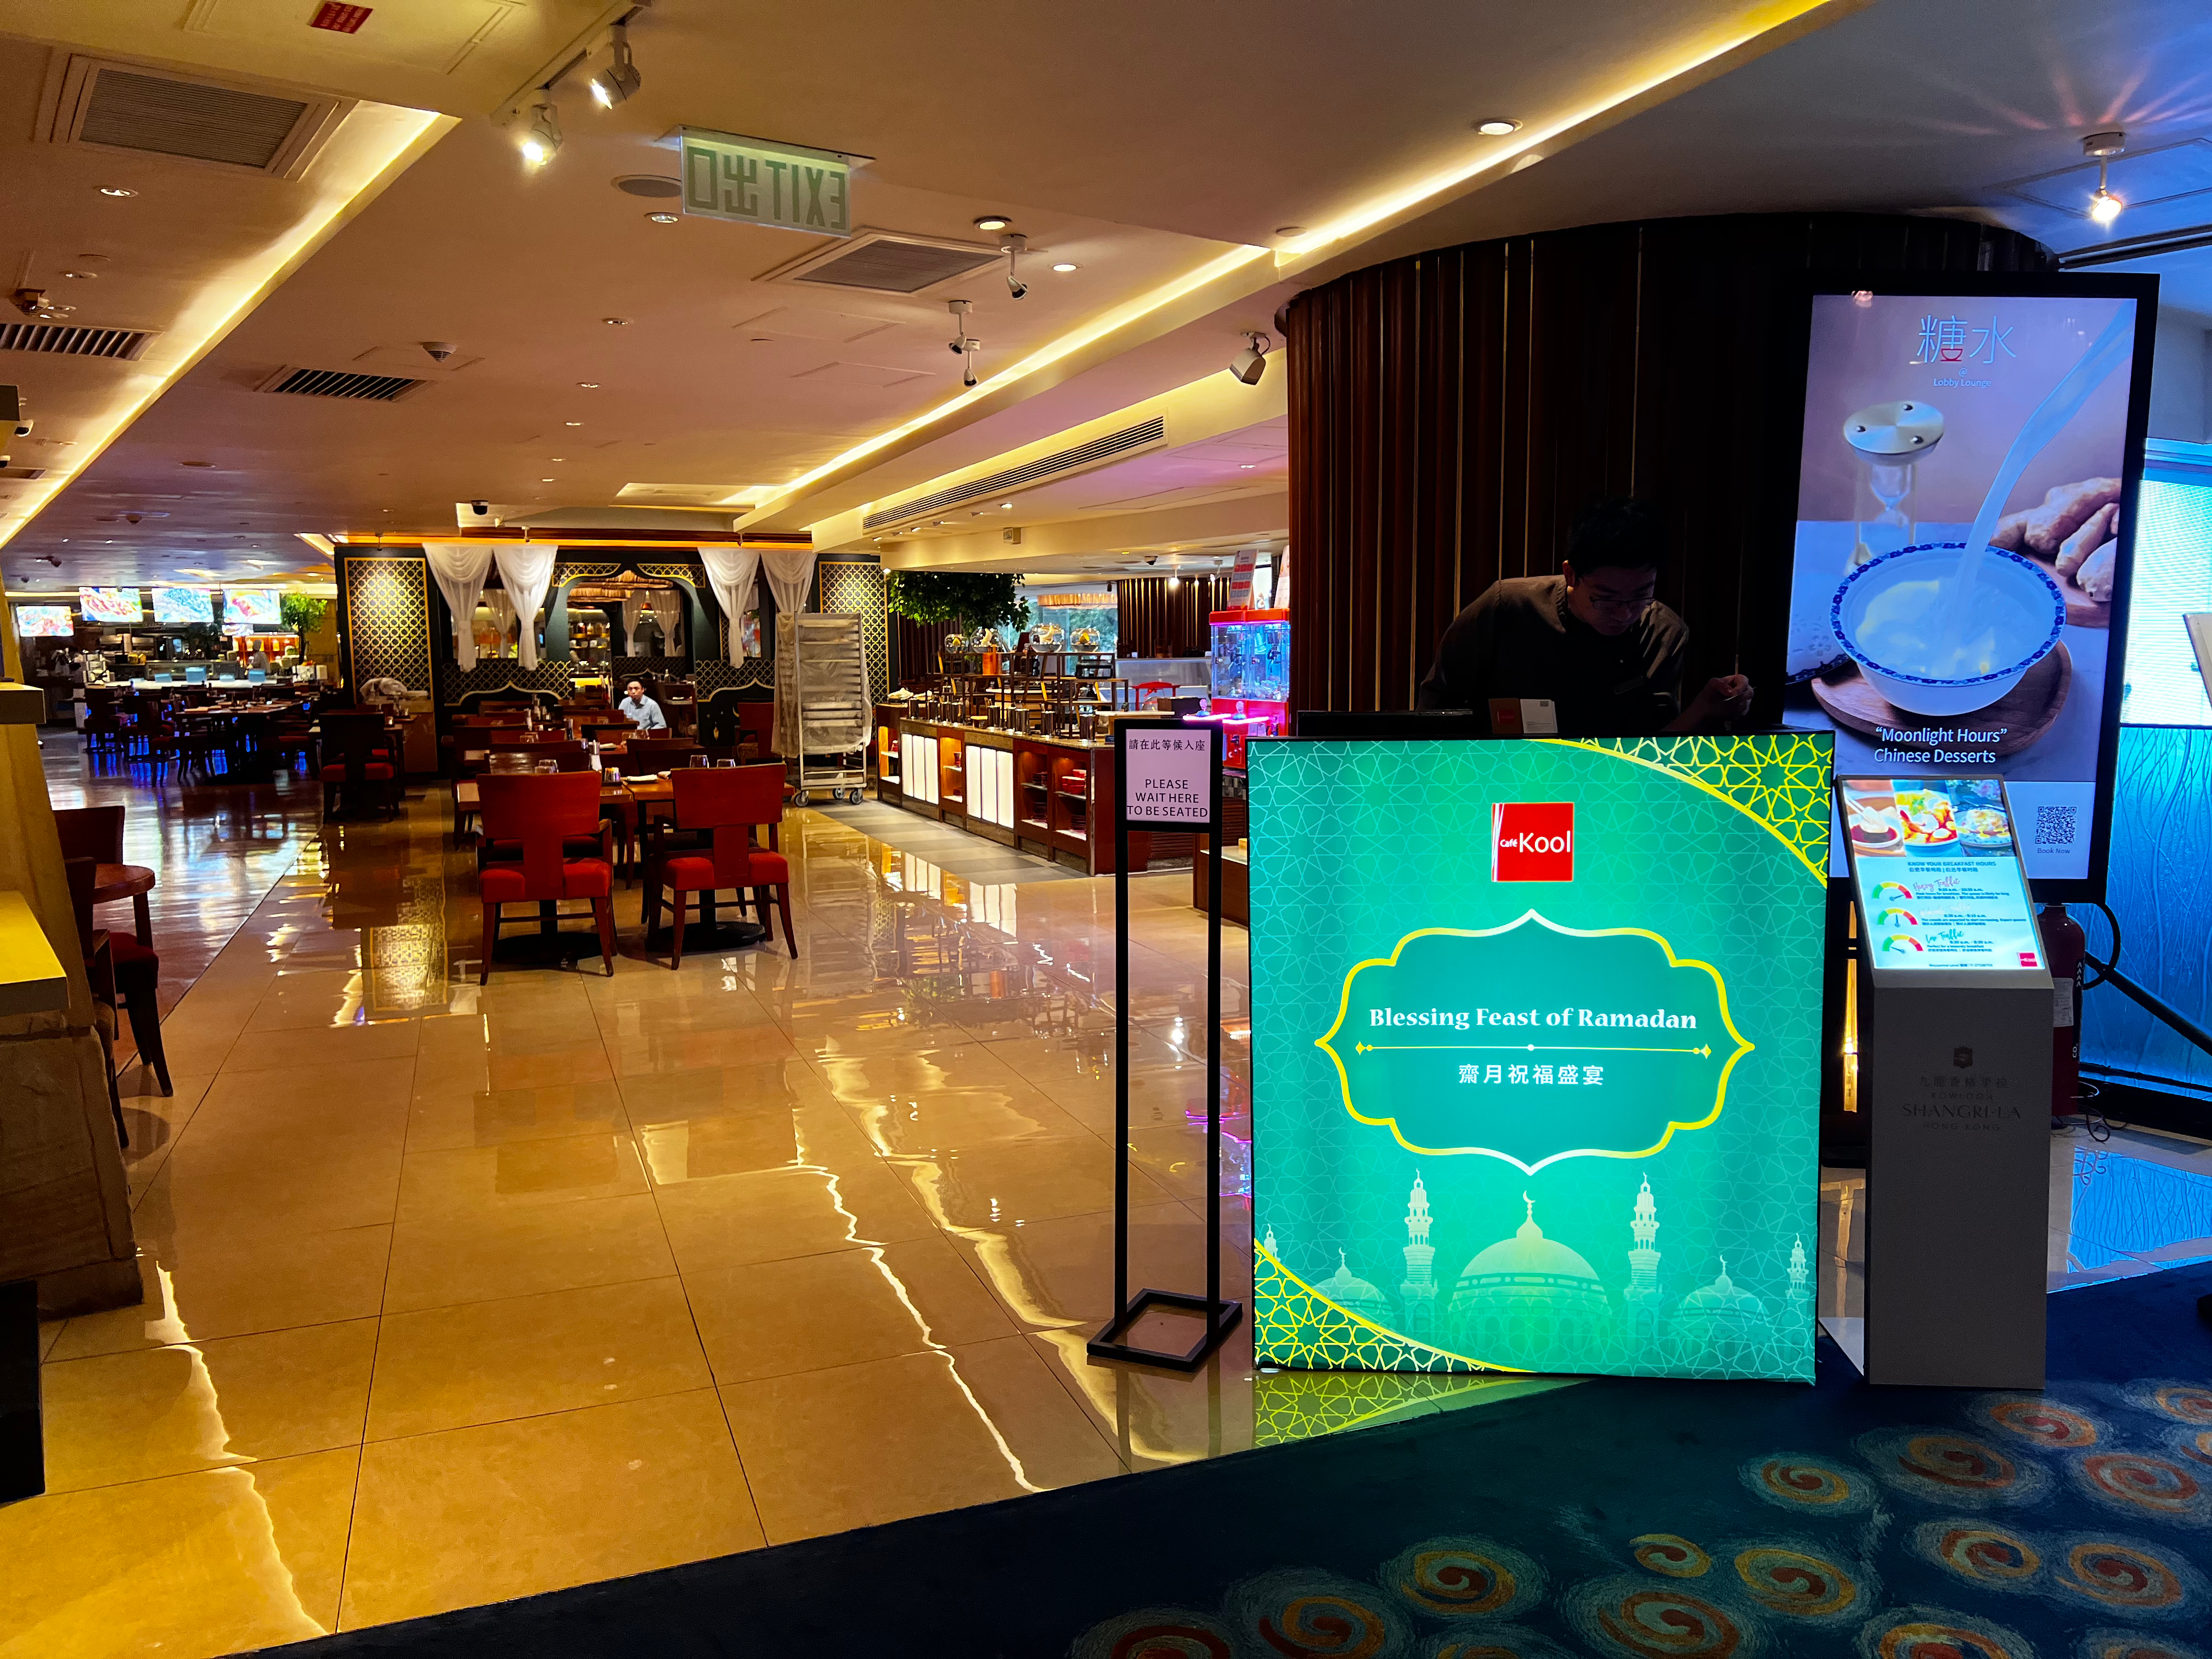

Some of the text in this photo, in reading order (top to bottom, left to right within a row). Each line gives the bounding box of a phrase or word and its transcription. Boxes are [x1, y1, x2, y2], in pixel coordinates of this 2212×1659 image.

[1917, 314, 2017, 364] 糖水
[1933, 378, 1991, 388] Lobby Lounge
[1128, 739, 1205, 751] 請在此等候入座
[1874, 748, 1996, 763] Chinese Desserts
[1145, 779, 1188, 789] PLEASE
[1135, 792, 1199, 803] WAIT HERE
[1126, 805, 1207, 817] TO BE SEATED
[1499, 831, 1571, 853] Café Kool
[1369, 1007, 1697, 1030] Blessing Feast of Ramadan
[1458, 1064, 1604, 1086] 齋月祝福盛宴
[1902, 1103, 2021, 1119] SHANGRI-LA
